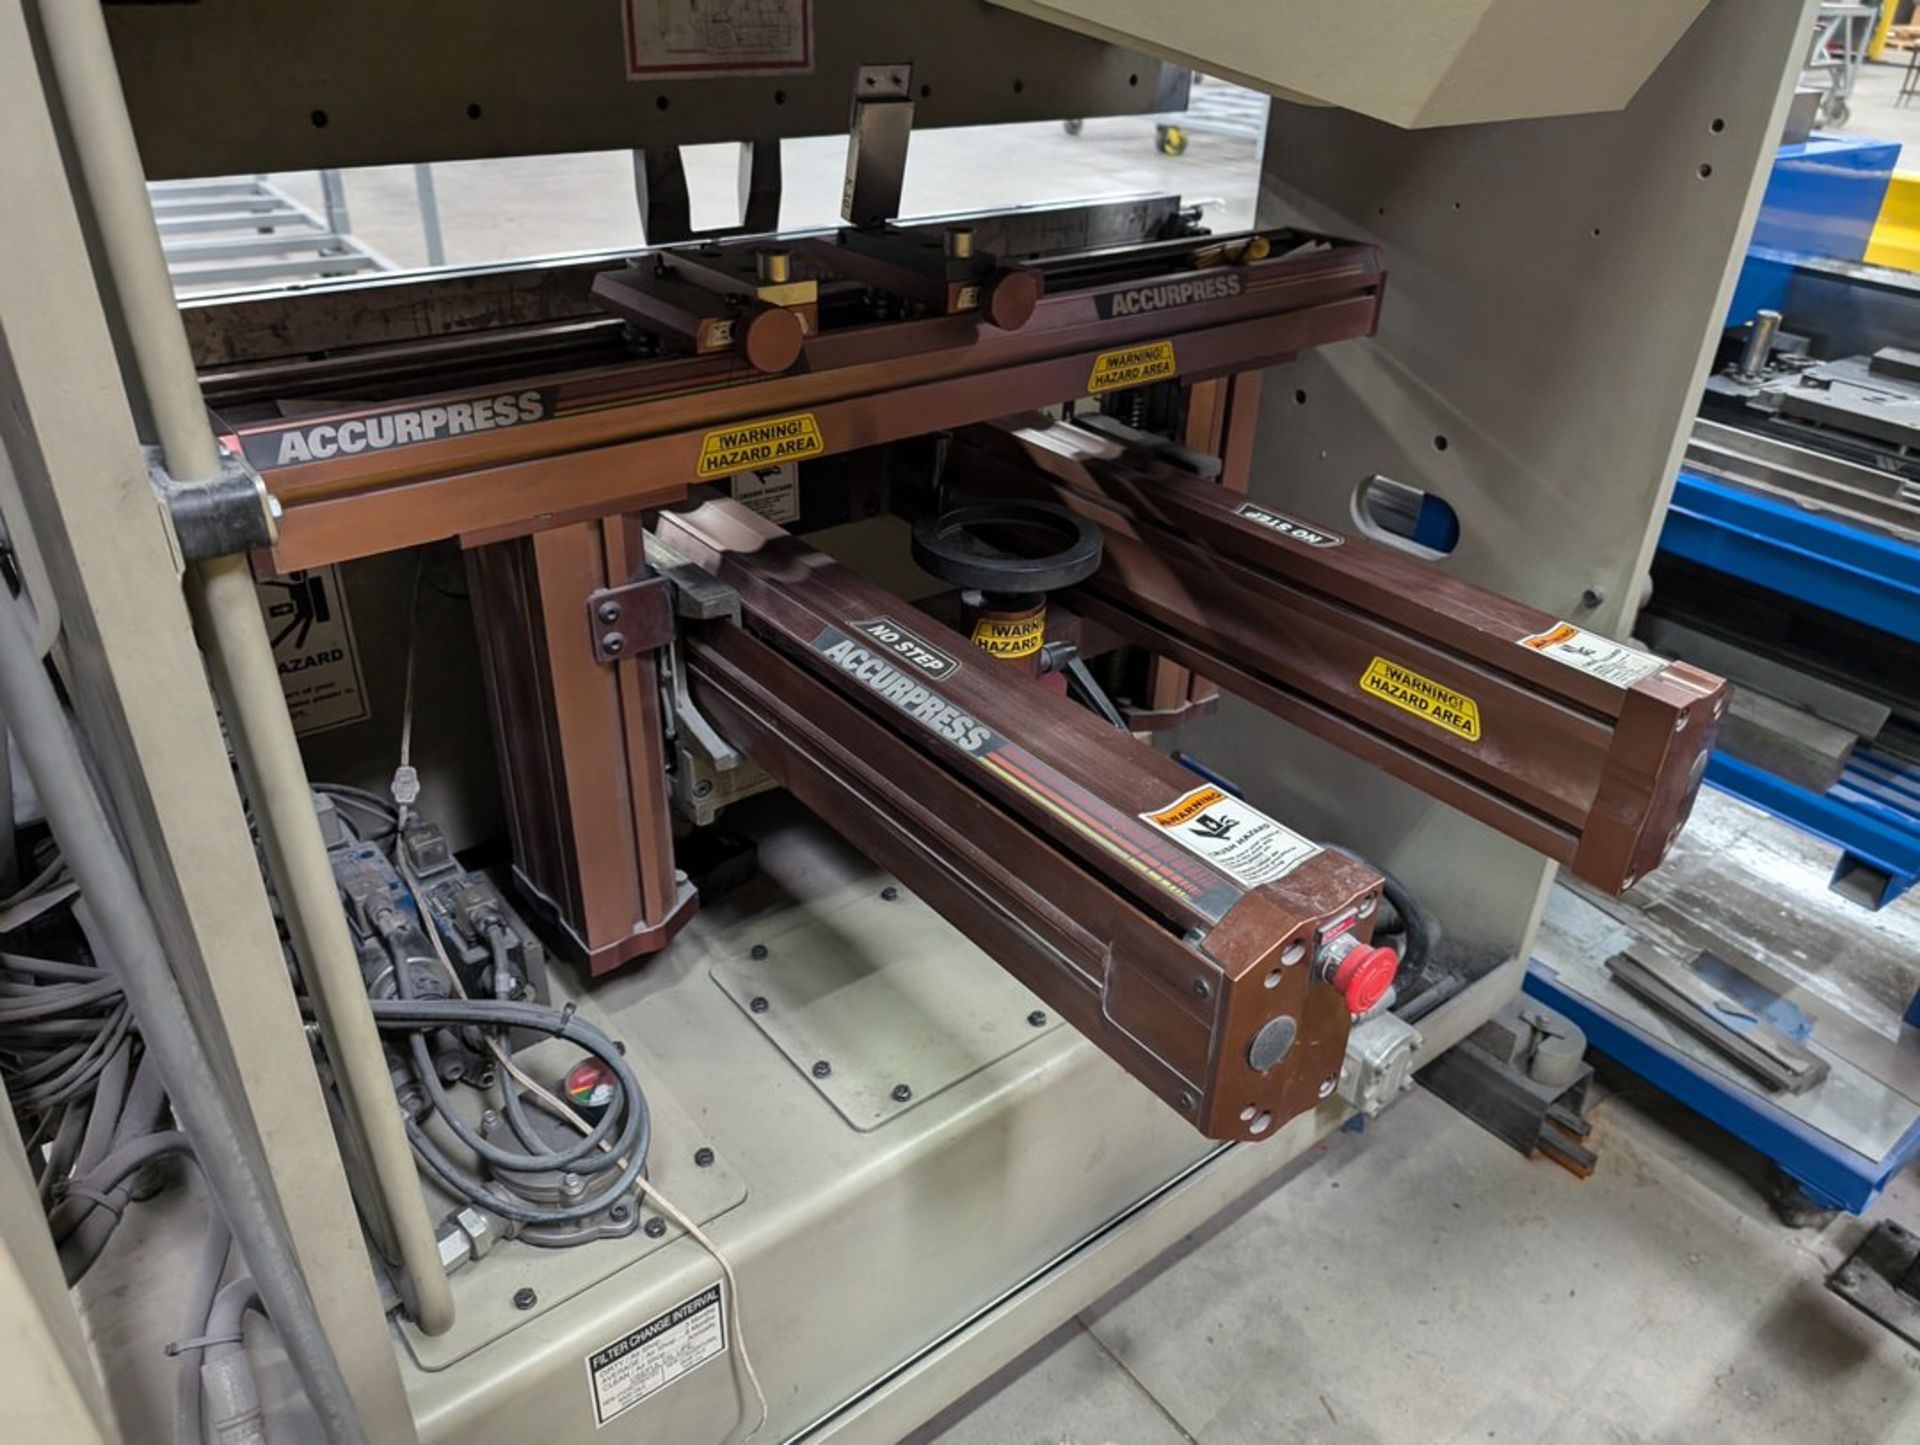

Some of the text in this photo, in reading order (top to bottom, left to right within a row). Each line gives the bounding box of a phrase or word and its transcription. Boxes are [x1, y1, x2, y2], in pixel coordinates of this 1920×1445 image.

[1111, 275, 1241, 316] ACCURPRESS
[1096, 361, 1170, 385] HAZARD AREA
[277, 391, 544, 465] ACCURPRESS
[707, 437, 816, 470] HAZARD AREA
[1245, 511, 1324, 544] NO STEP
[278, 649, 344, 674] AZARD
[867, 624, 945, 672] NO STEP
[824, 639, 992, 751] ACCURPRESS
[1369, 676, 1472, 732] HAZARD AREA
[1167, 792, 1222, 822] WARNING
[593, 1341, 628, 1368] FILTER
[629, 1316, 671, 1346] CHANGE
[672, 1290, 719, 1323] INTERVAL
